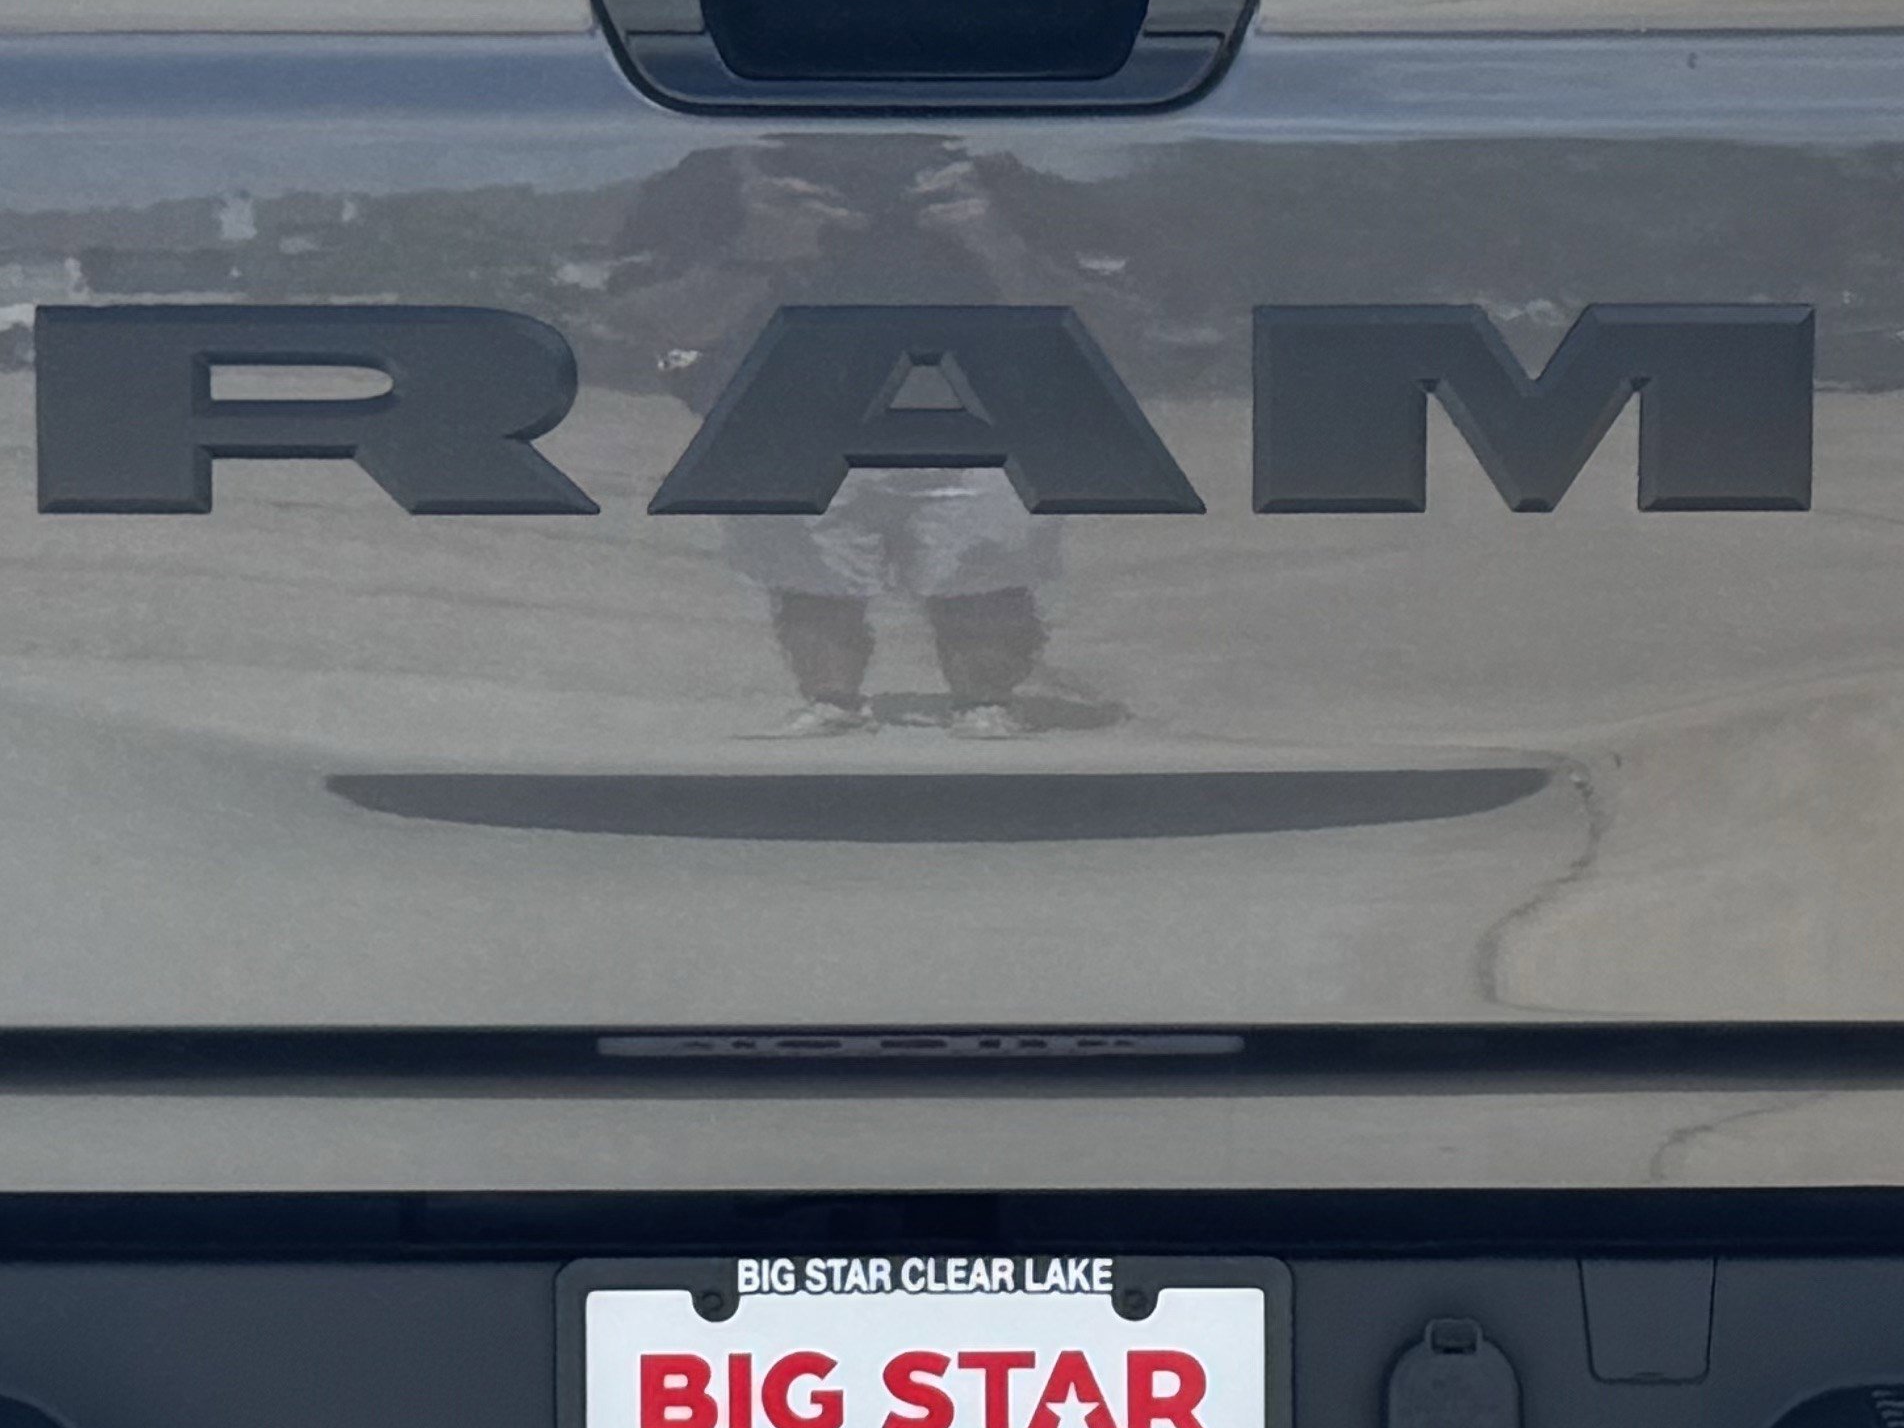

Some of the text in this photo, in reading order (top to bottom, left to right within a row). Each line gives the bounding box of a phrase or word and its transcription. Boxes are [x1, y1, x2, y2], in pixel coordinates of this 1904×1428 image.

[36, 303, 1814, 516] RAM
[737, 1256, 1114, 1293] BIG STAR CLEAR LAKE
